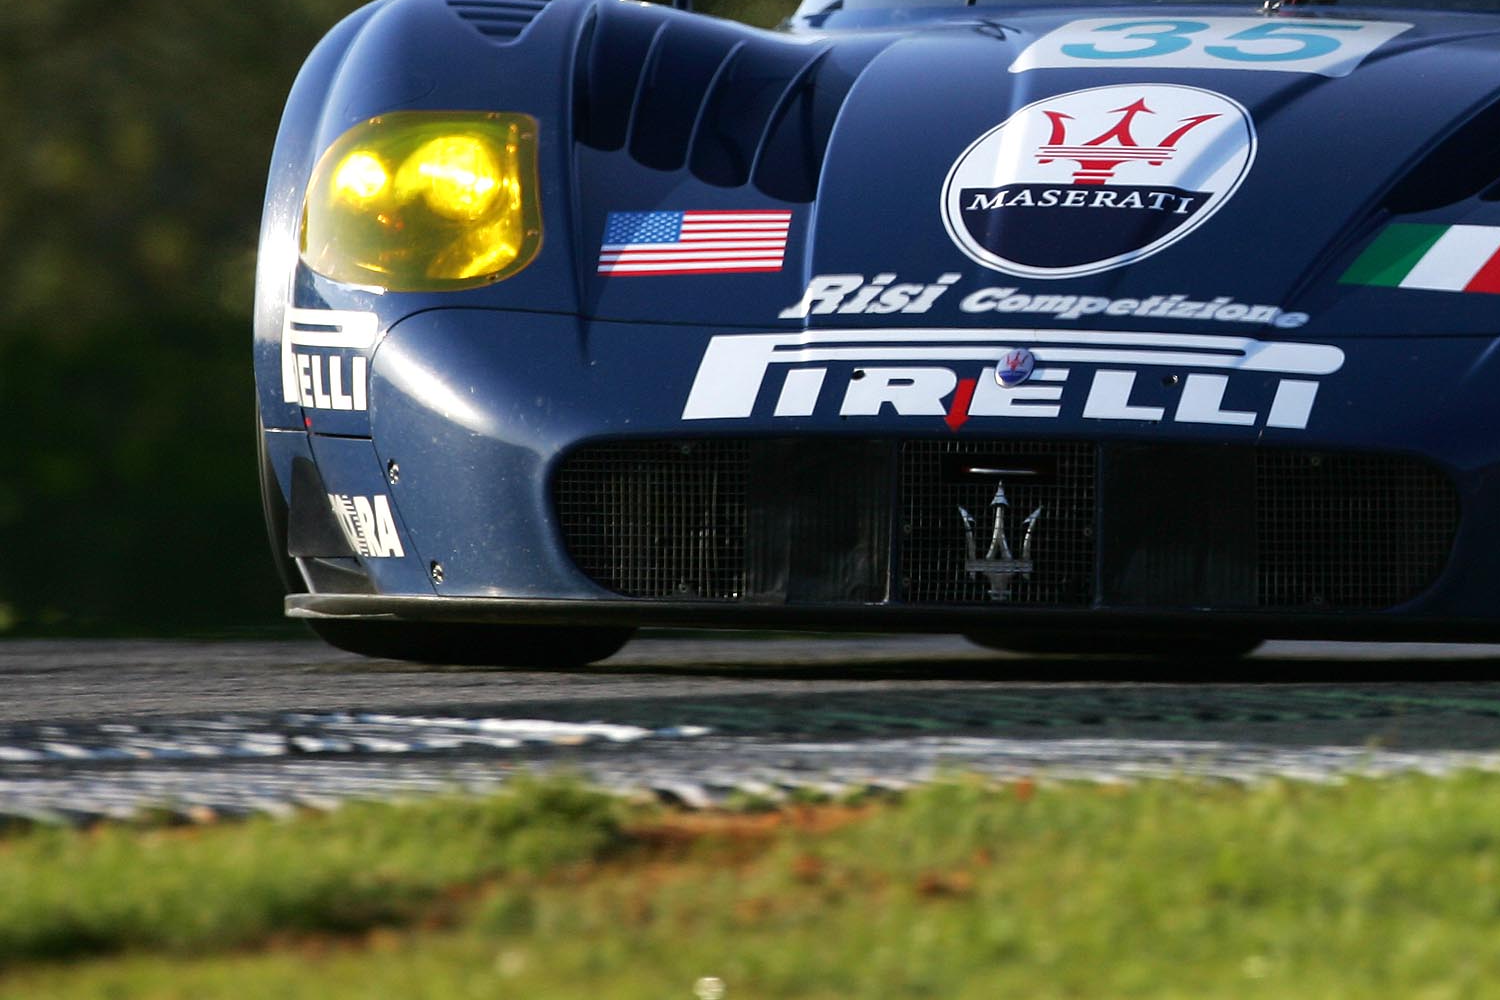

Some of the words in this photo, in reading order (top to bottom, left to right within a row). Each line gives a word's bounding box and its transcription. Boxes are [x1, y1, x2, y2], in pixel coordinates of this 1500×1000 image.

[1062, 20, 1364, 63] 35
[966, 188, 1196, 215] MASERATI
[779, 273, 961, 319] Risi
[959, 287, 1310, 329] Competizione
[281, 308, 379, 411] PELLI
[682, 329, 1346, 430] PIRELLI
